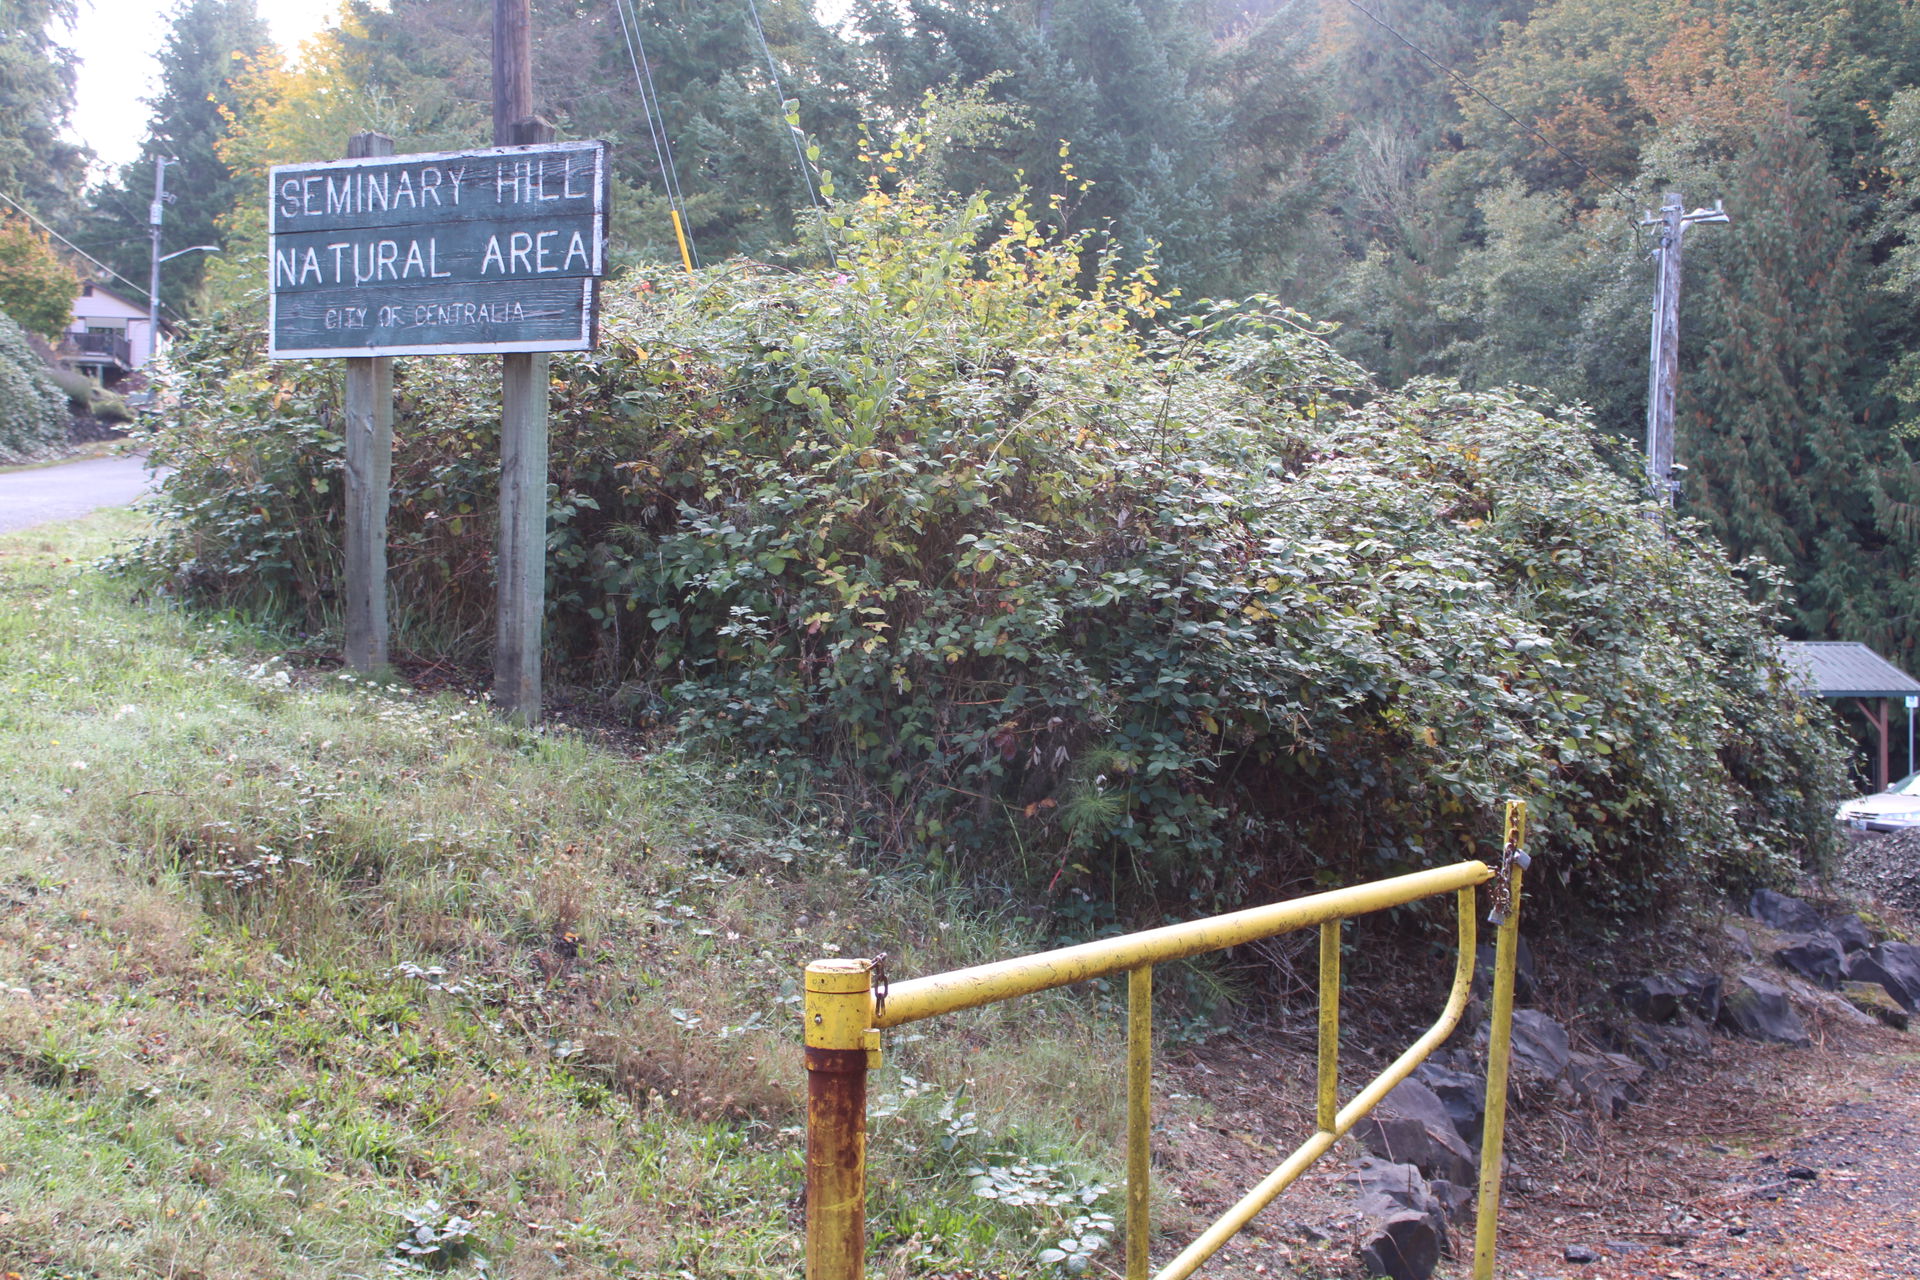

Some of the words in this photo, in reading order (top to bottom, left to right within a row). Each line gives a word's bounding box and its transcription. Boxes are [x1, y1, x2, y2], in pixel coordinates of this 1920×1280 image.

[281, 166, 466, 218] SEMINARY
[497, 158, 588, 204] HILL
[276, 238, 451, 288] NATURAL
[481, 230, 589, 275] AREA
[325, 307, 367, 330] CITY
[380, 306, 403, 328] OF
[415, 302, 524, 326] CENTRALIA
